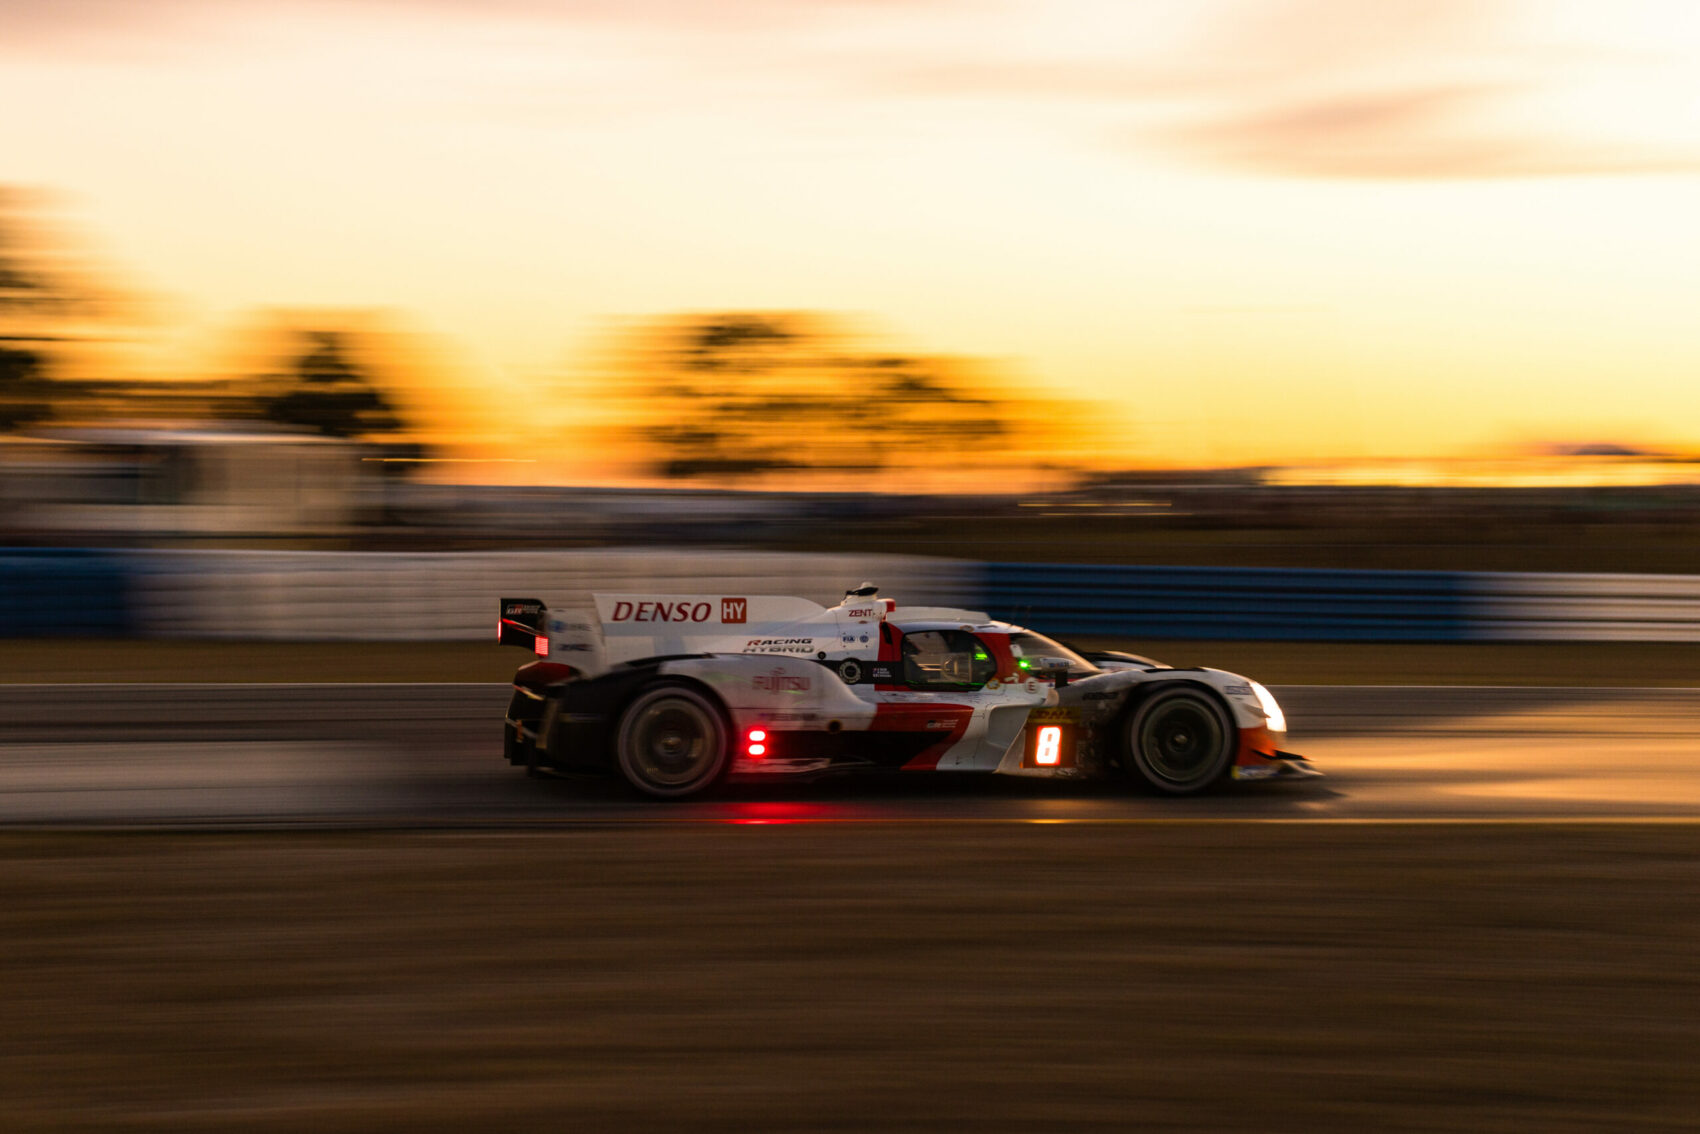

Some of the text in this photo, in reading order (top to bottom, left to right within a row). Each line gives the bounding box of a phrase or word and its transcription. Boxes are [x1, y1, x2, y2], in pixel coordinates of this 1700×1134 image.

[611, 601, 745, 622] DENSO HY
[848, 609, 873, 617] ZENT
[747, 638, 813, 647] RACING
[752, 675, 812, 694] FUJITSU
[1035, 725, 1062, 765] 8
